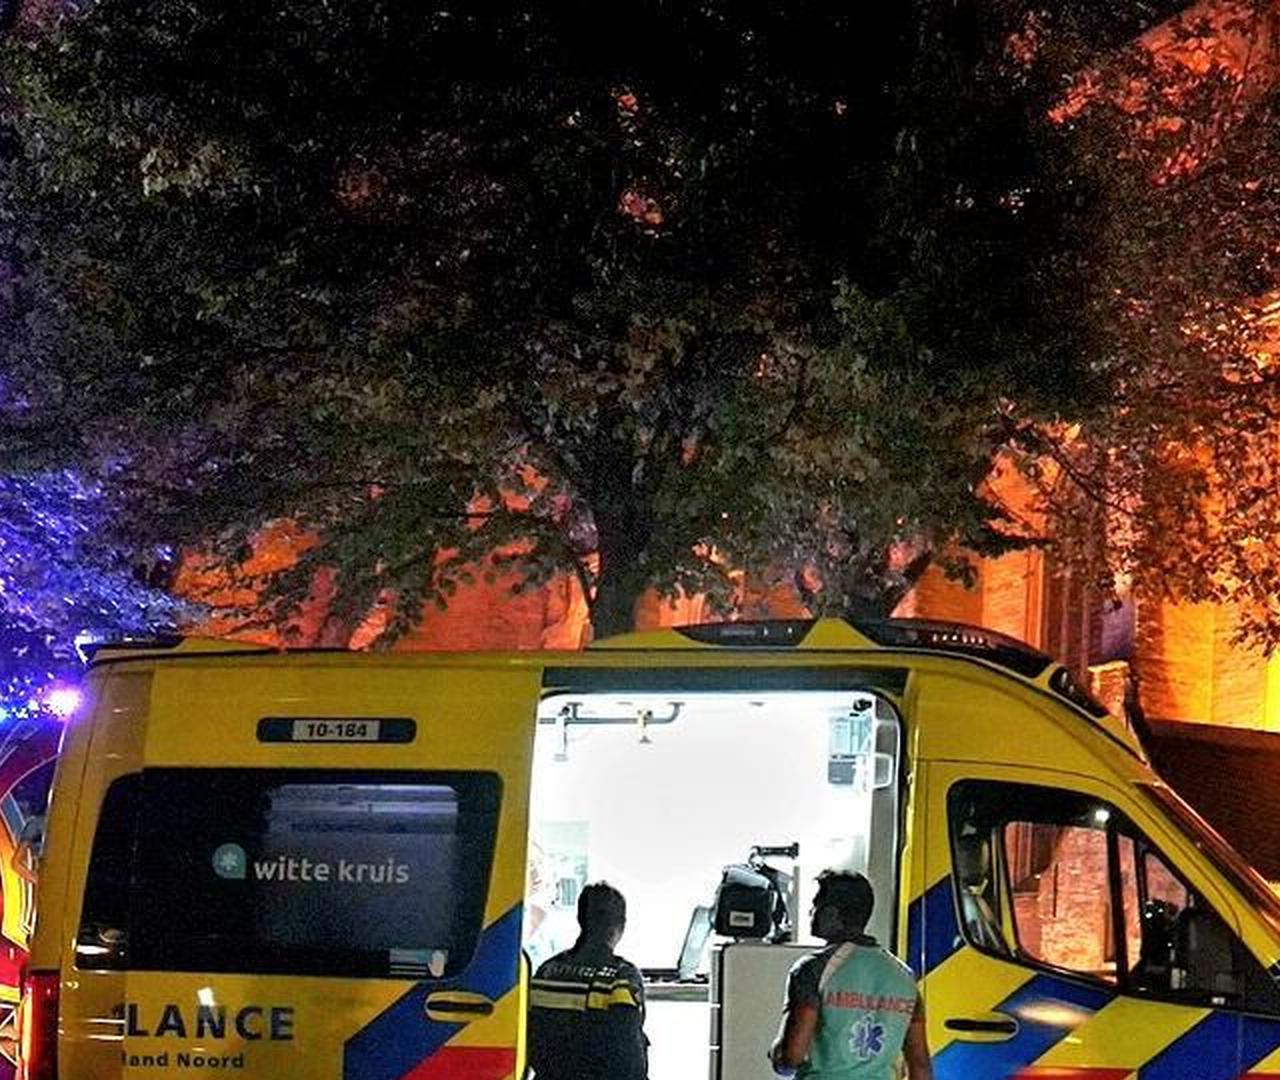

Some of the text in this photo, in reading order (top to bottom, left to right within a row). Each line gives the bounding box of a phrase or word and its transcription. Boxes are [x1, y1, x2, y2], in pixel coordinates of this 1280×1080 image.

[253, 856, 410, 883] witte kruis
[825, 991, 915, 1013] AMBULANCE
[176, 1053, 245, 1069] Noord
